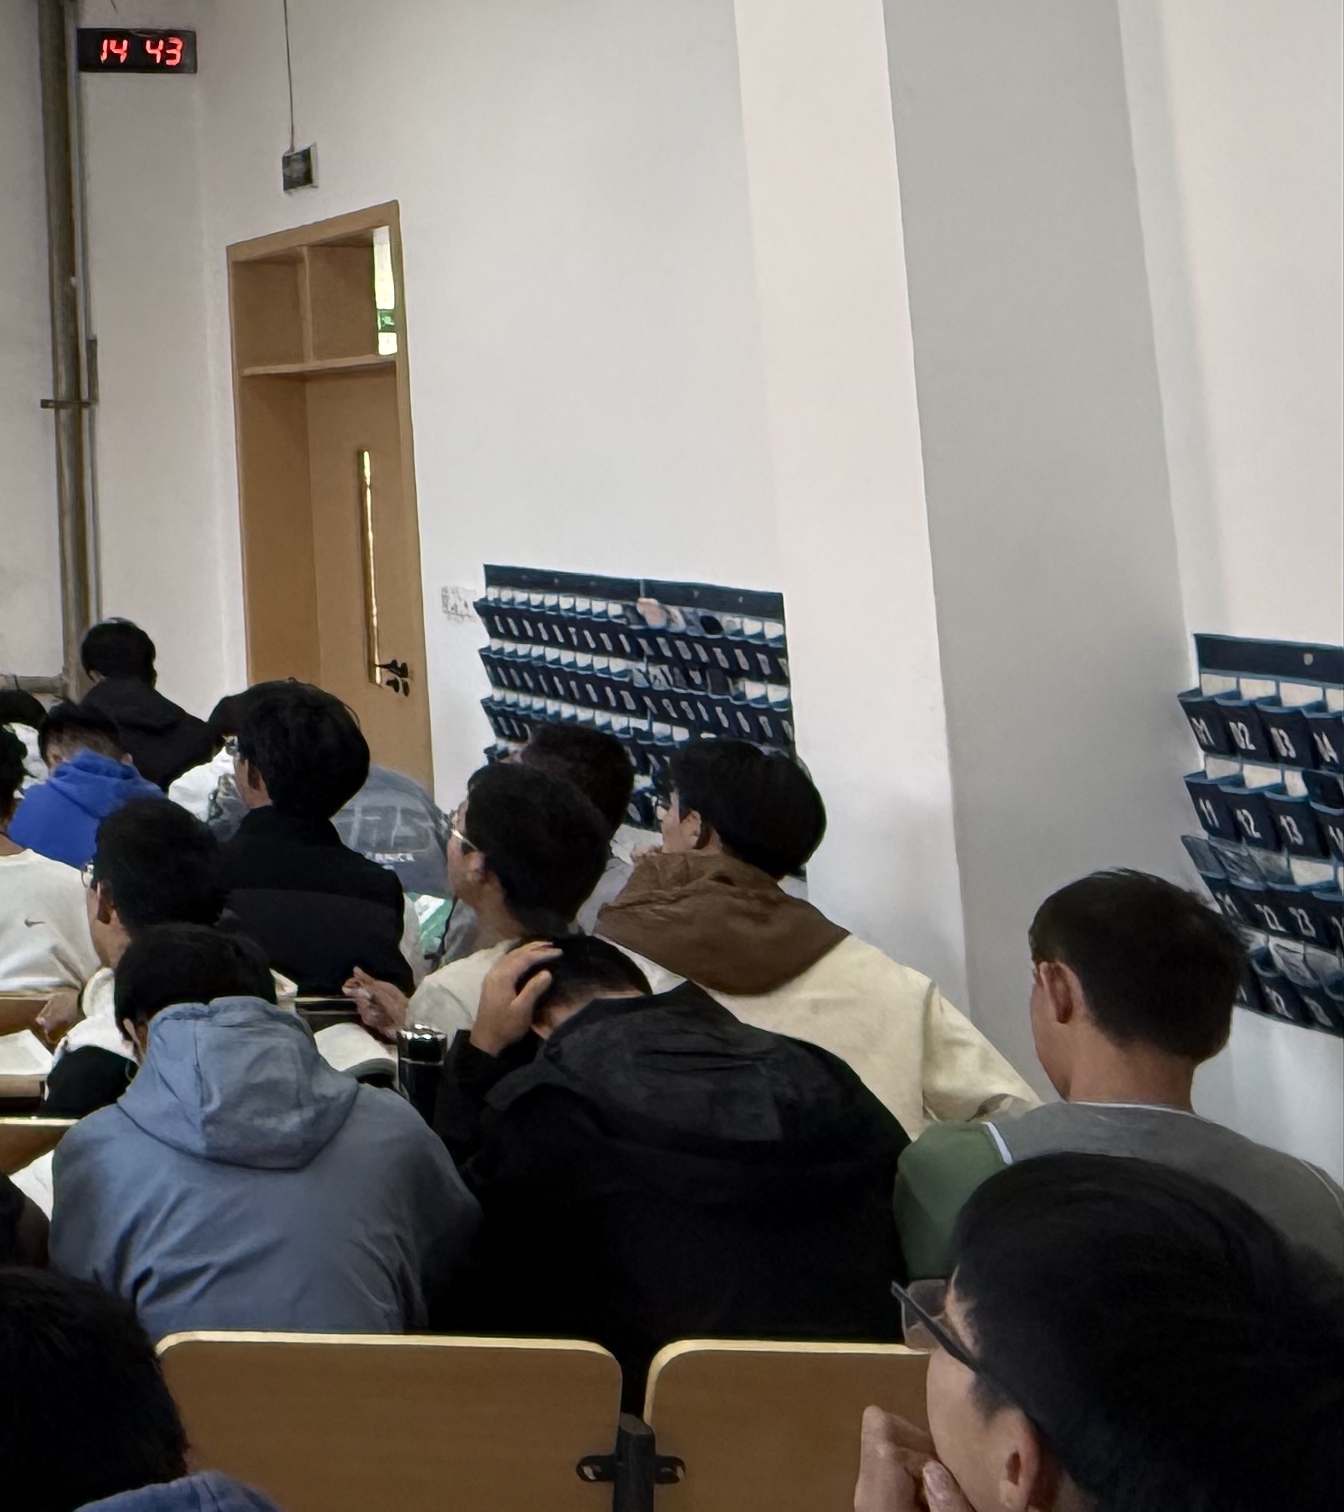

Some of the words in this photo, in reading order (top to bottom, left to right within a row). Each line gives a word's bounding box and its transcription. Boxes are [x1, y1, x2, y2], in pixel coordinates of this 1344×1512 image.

[1229, 721, 1257, 750] 02
[1270, 727, 1297, 759] 03
[1198, 798, 1220, 829] 11
[1235, 809, 1262, 839] 12
[1279, 815, 1304, 845] 13
